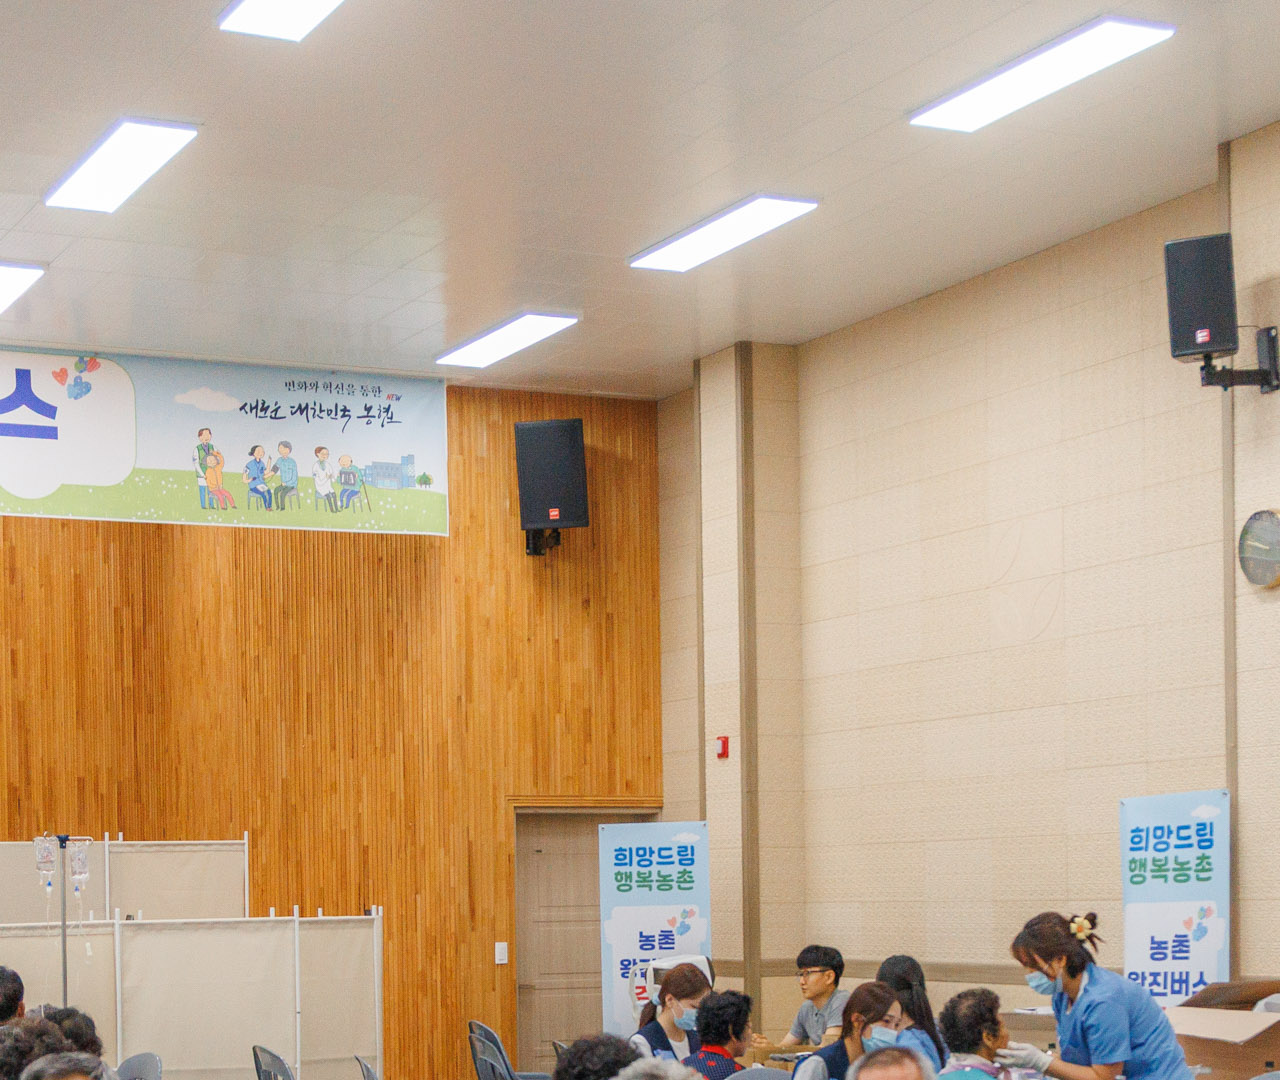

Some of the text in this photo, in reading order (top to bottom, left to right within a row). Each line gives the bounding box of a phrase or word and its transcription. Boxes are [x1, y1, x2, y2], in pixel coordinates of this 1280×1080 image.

[386, 393, 402, 402] NEW
[239, 398, 286, 420] 새로운
[290, 400, 352, 433] 대한민국
[1129, 821, 1215, 853] 희망드림
[613, 845, 695, 868] 희망드림
[1128, 853, 1214, 885] 행복농촌
[613, 868, 695, 893] 행복농촌
[638, 930, 675, 951] 농촌
[1150, 934, 1190, 961] 농촌
